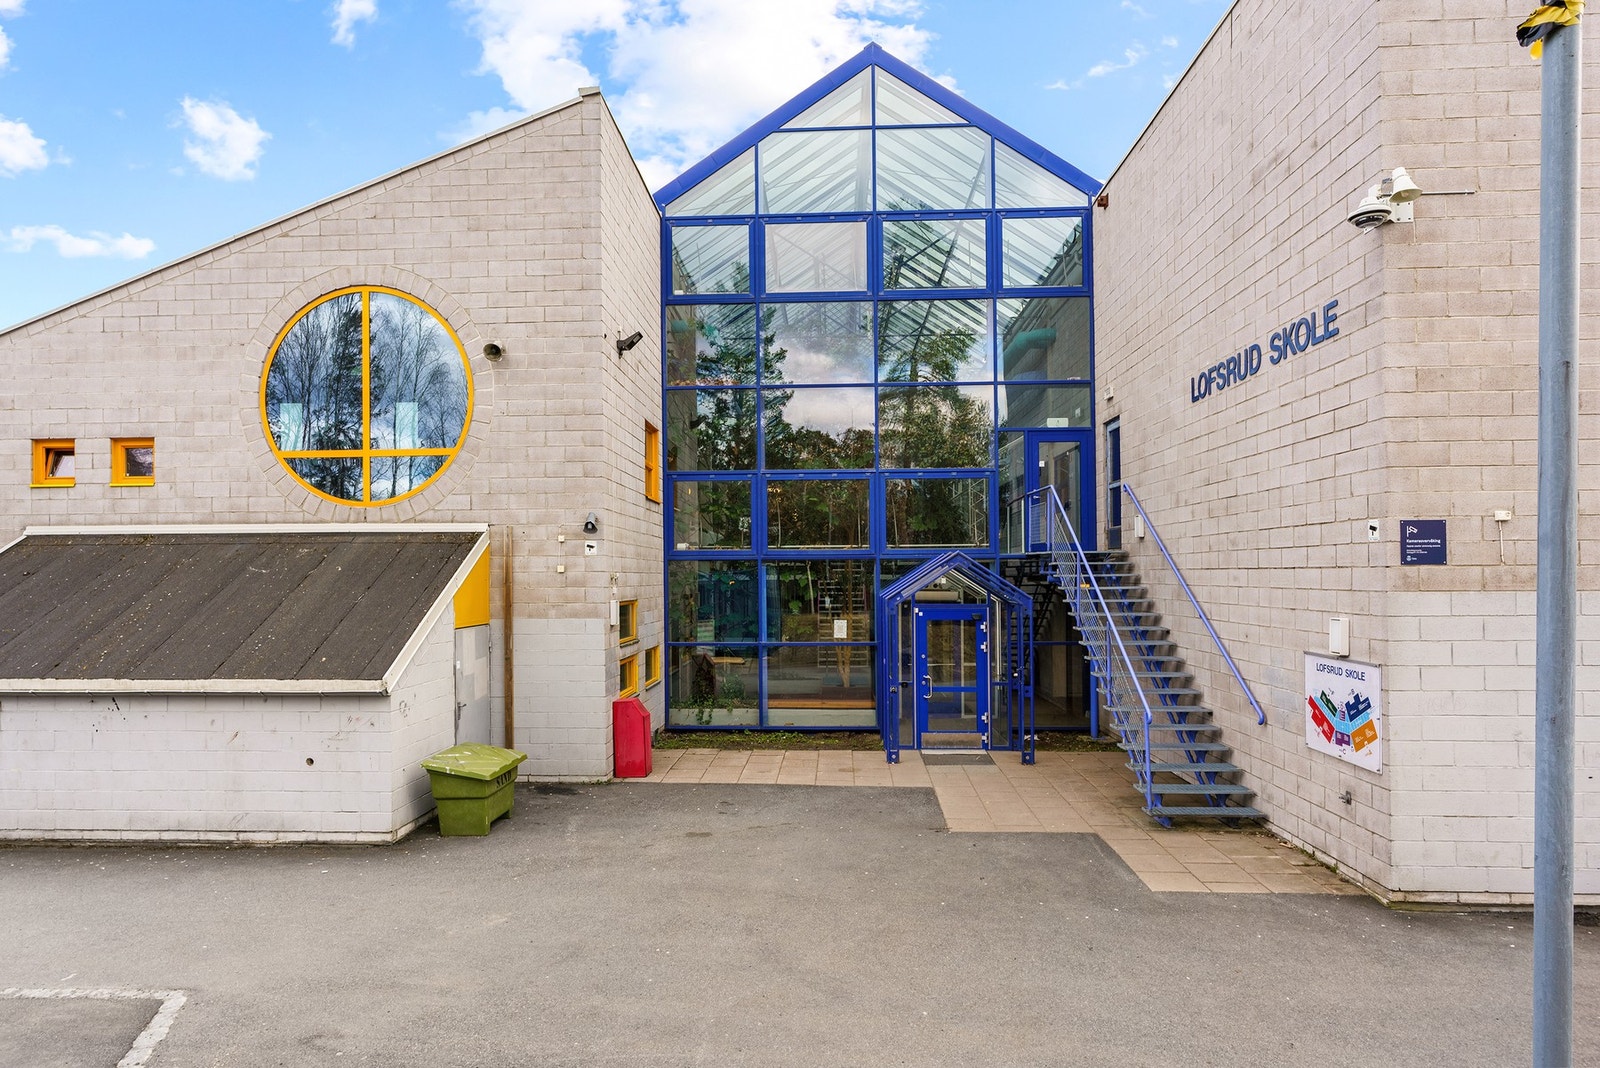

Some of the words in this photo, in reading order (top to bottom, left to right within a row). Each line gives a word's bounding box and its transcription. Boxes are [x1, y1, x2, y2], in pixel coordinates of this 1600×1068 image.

[1191, 344, 1262, 403] LOFSRUD
[1269, 299, 1340, 365] SKOLE
[1316, 663, 1343, 676] LOFSRUD
[1345, 668, 1366, 681] SKOLE
